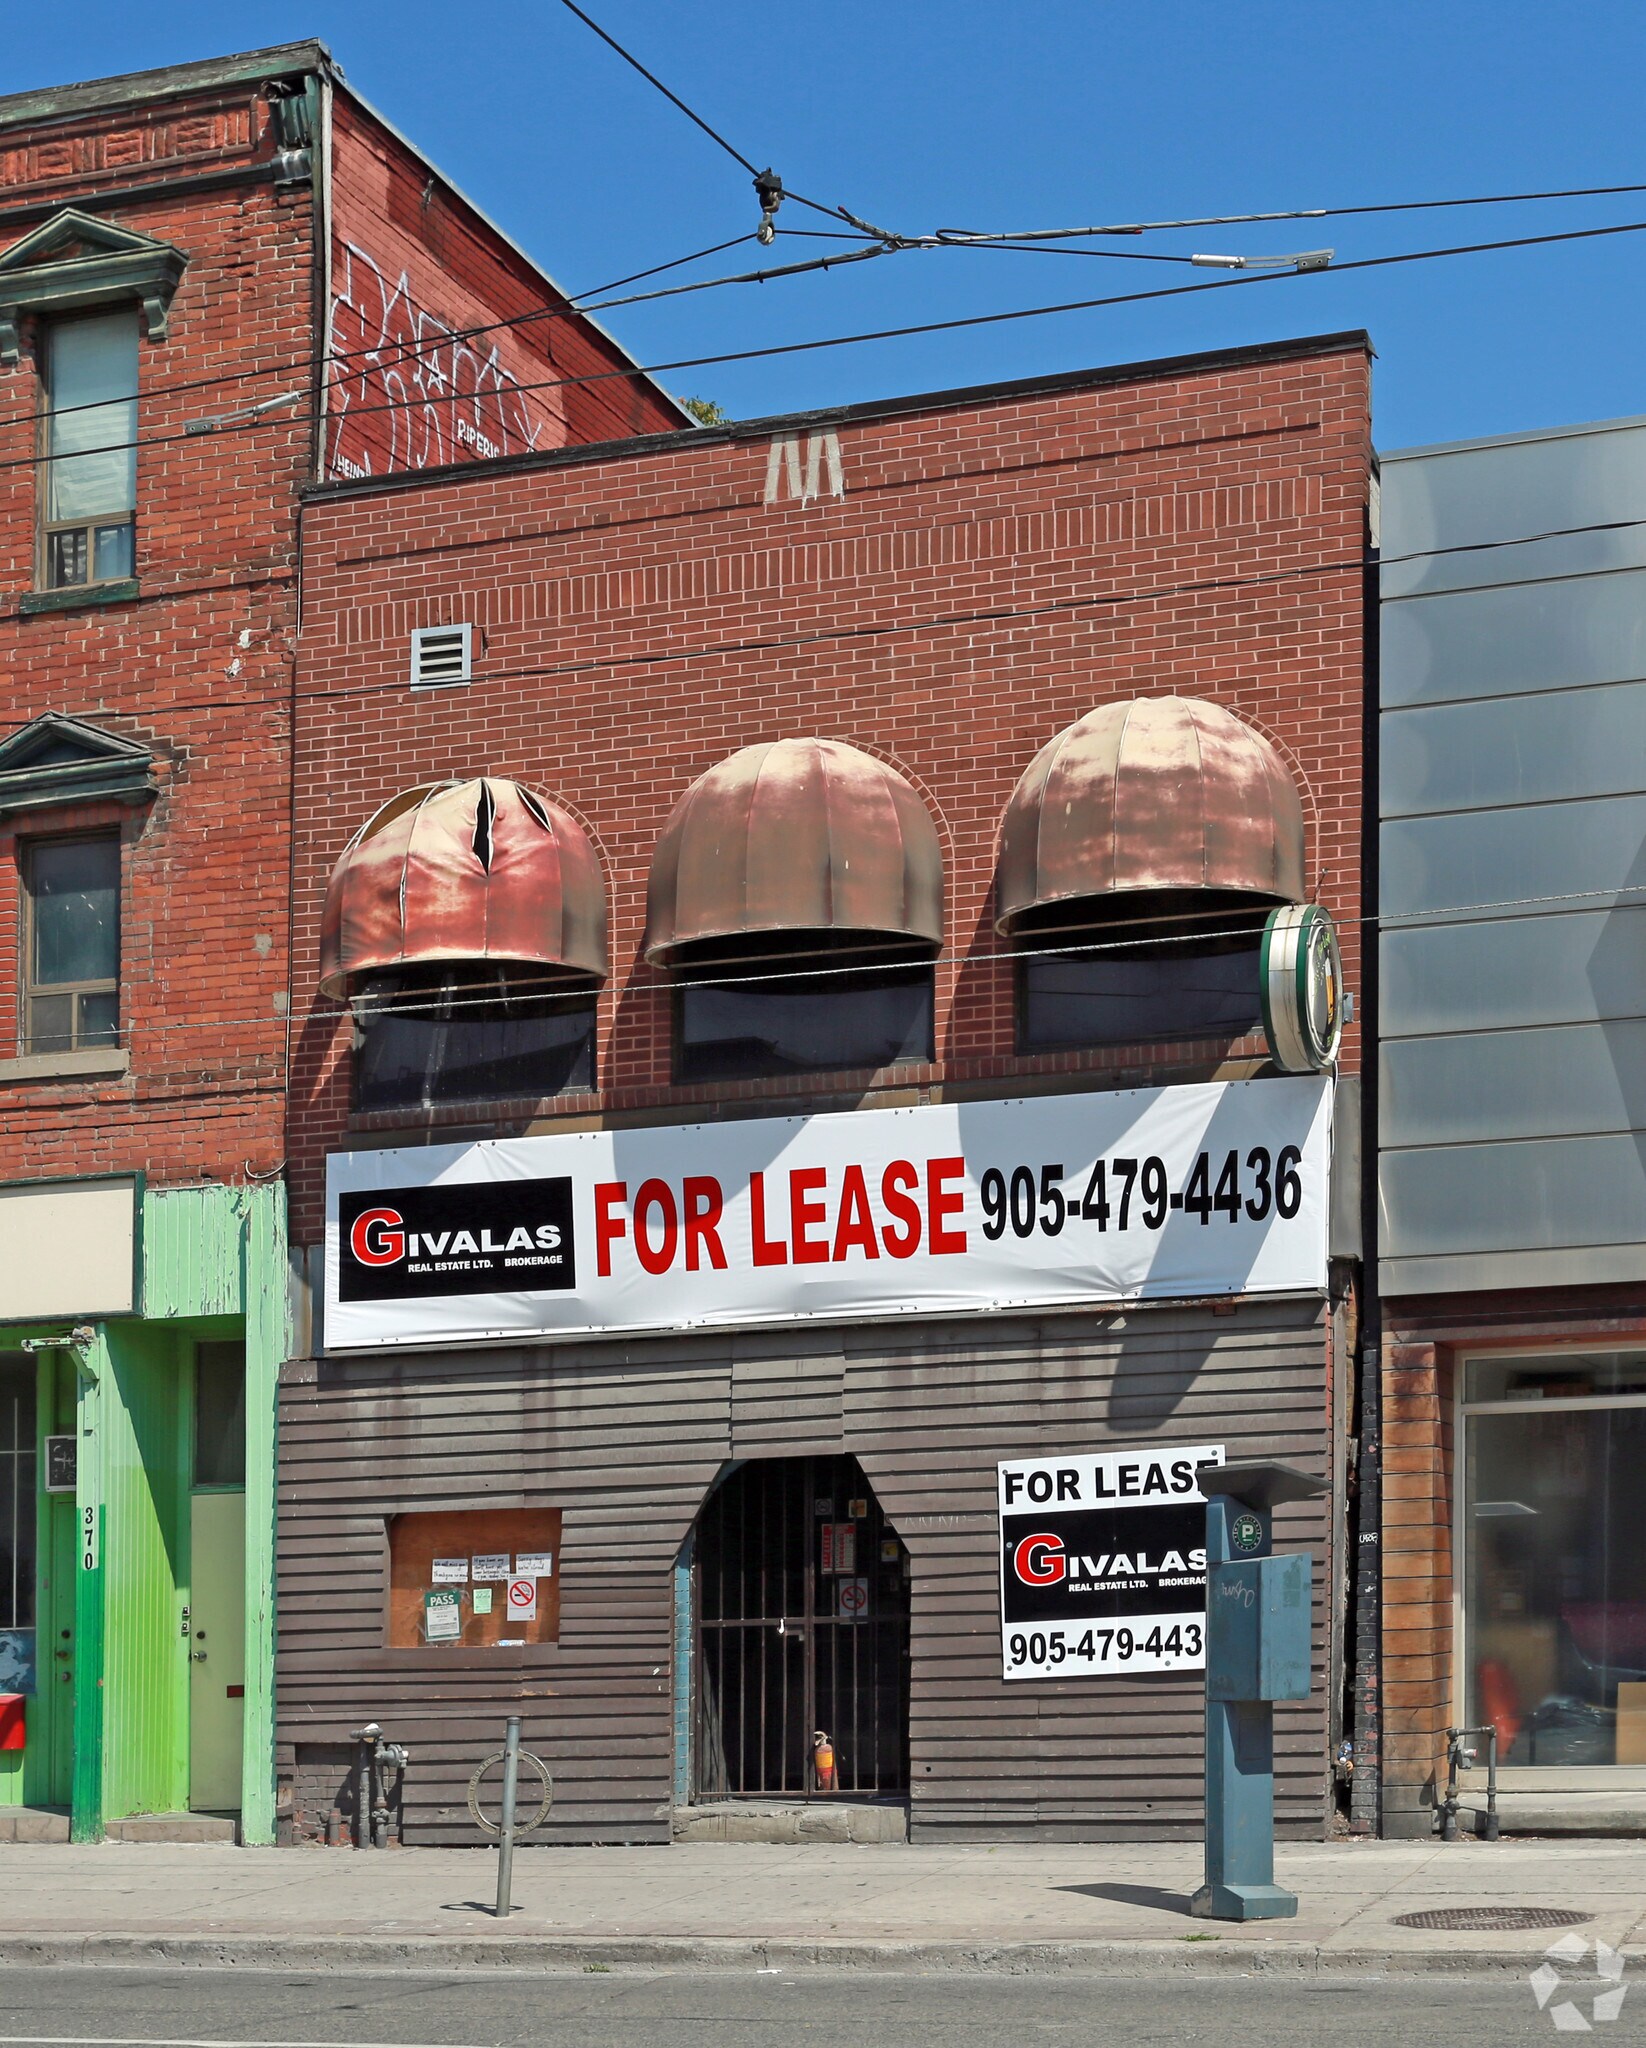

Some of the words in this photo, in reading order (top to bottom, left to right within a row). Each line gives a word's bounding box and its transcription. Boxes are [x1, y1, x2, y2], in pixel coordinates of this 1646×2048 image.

[351, 1207, 562, 1267] GIVALAS
[594, 1175, 728, 1278] FOR
[749, 1156, 967, 1267] LEASE
[980, 1144, 1303, 1241] 905-479-4436
[408, 1262, 433, 1273] REAL
[435, 1260, 471, 1272] ESTATE
[472, 1259, 494, 1270] LTD.
[504, 1254, 563, 1267] BROKERAGE
[1005, 1469, 1082, 1505] FOR
[85, 1506, 94, 1570] 370
[1014, 1532, 1207, 1587] GIVALAS
[430, 1594, 455, 1607] PASS
[1068, 1583, 1092, 1593] REAL
[1094, 1581, 1128, 1591] ESTATE
[1129, 1580, 1149, 1590] LTD.
[1158, 1576, 1207, 1587] BROKERAG
[1009, 1623, 1203, 1666] 905-479-443
